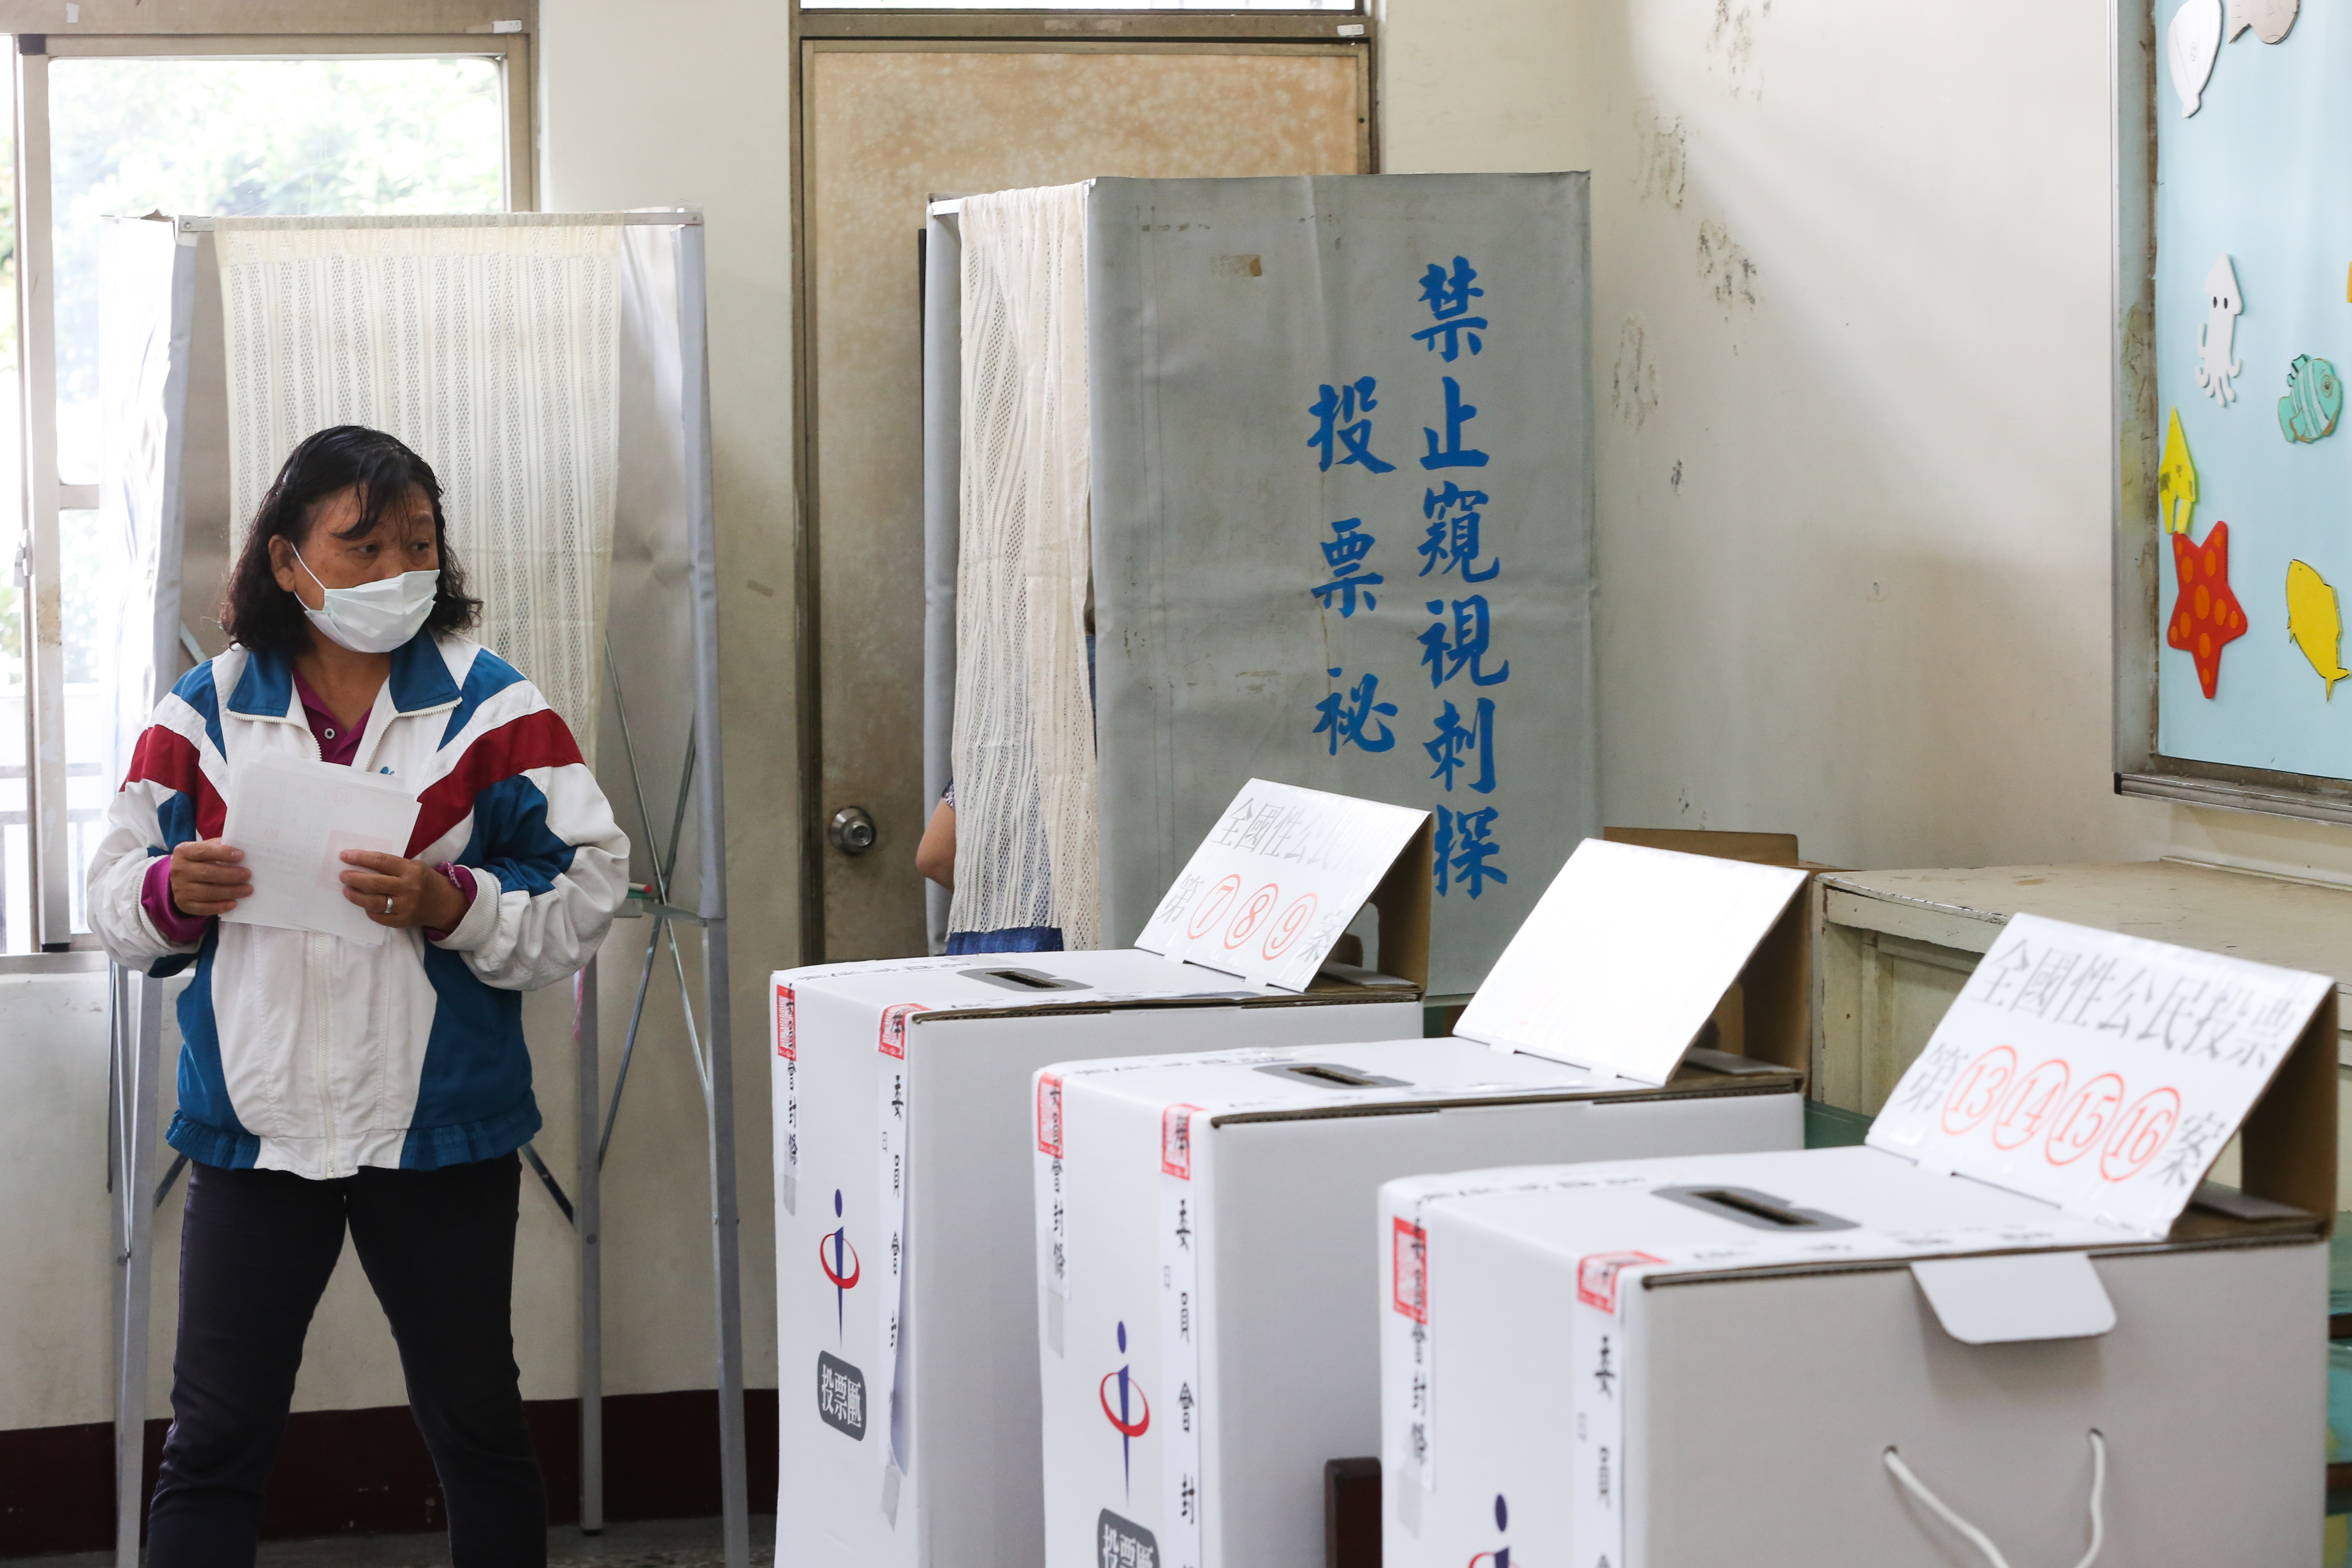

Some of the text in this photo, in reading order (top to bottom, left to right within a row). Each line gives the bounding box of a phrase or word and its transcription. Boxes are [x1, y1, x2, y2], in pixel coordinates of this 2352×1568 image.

[1411, 256, 1509, 900] 禁止窺視刺探
[1968, 939, 2306, 1070] 全國性公民投票
